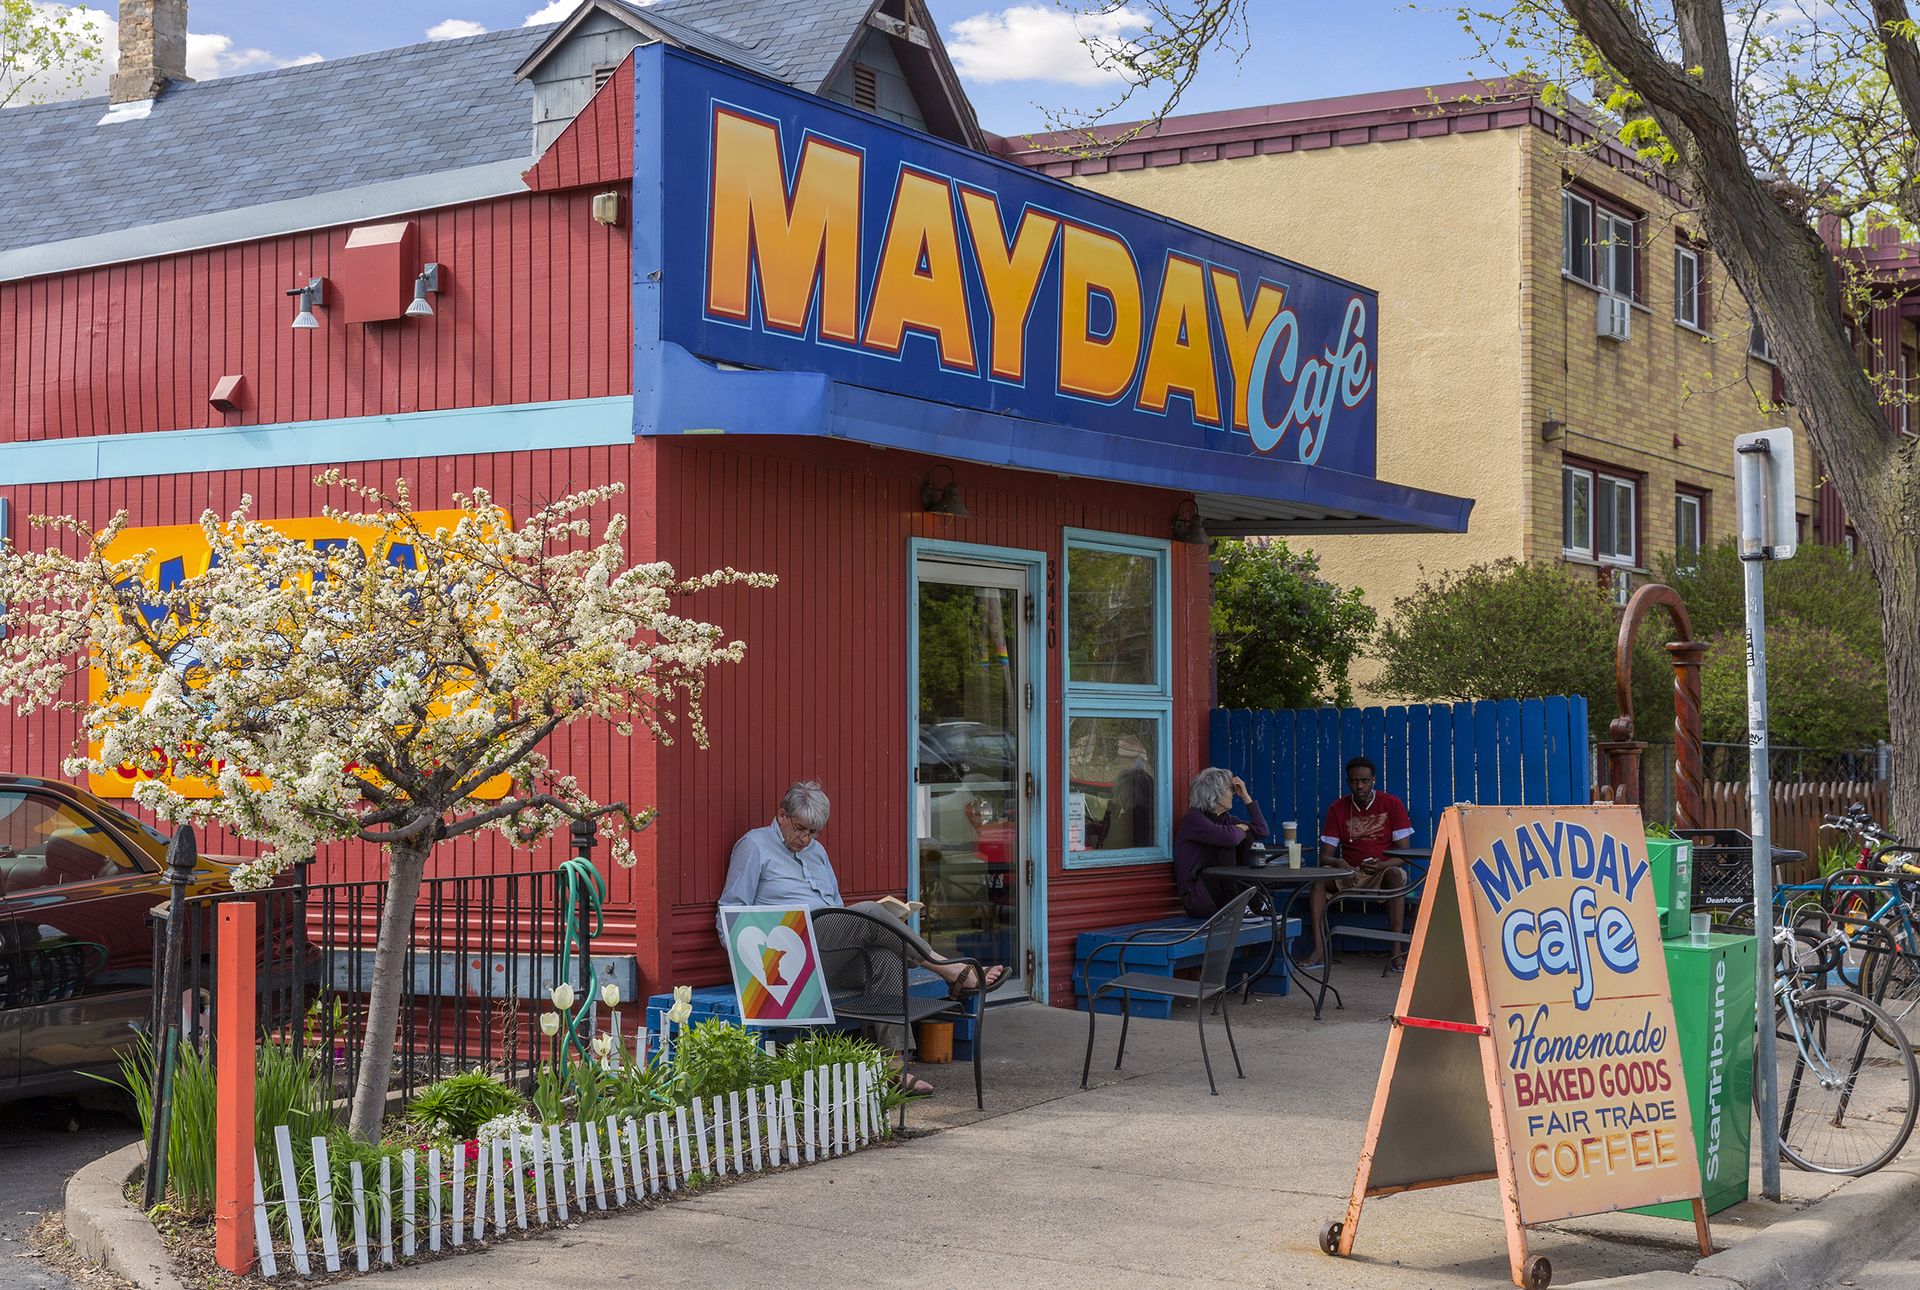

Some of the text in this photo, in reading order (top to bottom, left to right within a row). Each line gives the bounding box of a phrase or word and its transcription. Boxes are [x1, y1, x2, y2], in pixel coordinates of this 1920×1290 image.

[703, 97, 1373, 467] MAYDAY Cafe
[1047, 559, 1056, 650] 3440
[1470, 820, 1650, 916] MAYDAY
[1501, 885, 1640, 1011] cafe
[1508, 1003, 1667, 1070] Homemade
[1706, 960, 1726, 1182] StarTribune
[1513, 1057, 1673, 1108] BAKED GOODS
[1527, 1100, 1678, 1137] FAIR TRADE
[1526, 1127, 1680, 1187] COFFEE
